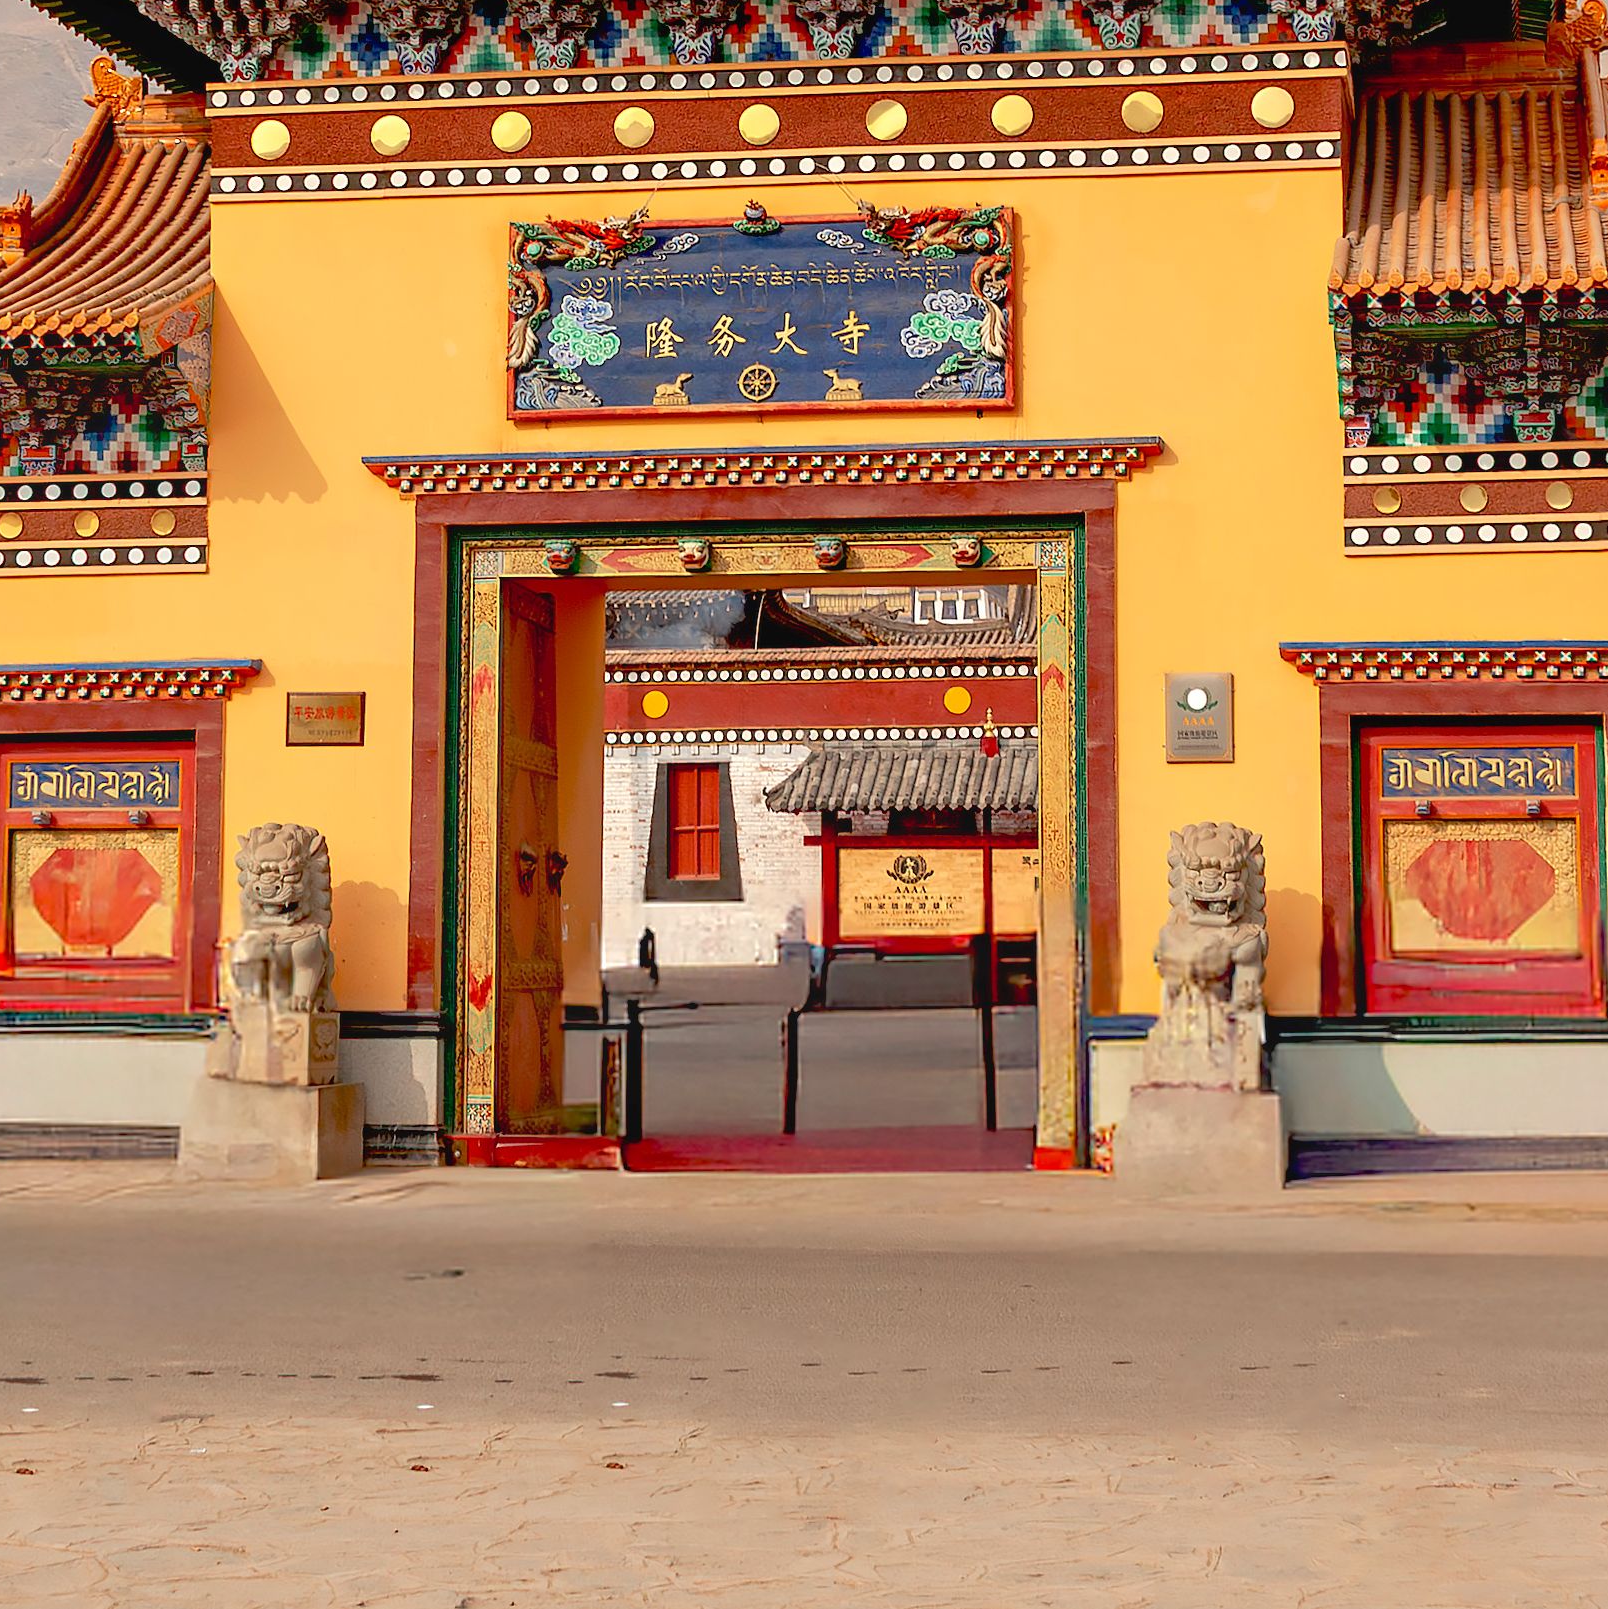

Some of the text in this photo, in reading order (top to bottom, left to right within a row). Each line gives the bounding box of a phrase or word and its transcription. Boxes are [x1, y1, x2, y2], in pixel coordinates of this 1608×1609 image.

[645, 310, 872, 359] 隆务大寺
[894, 885, 928, 894] AAAA
